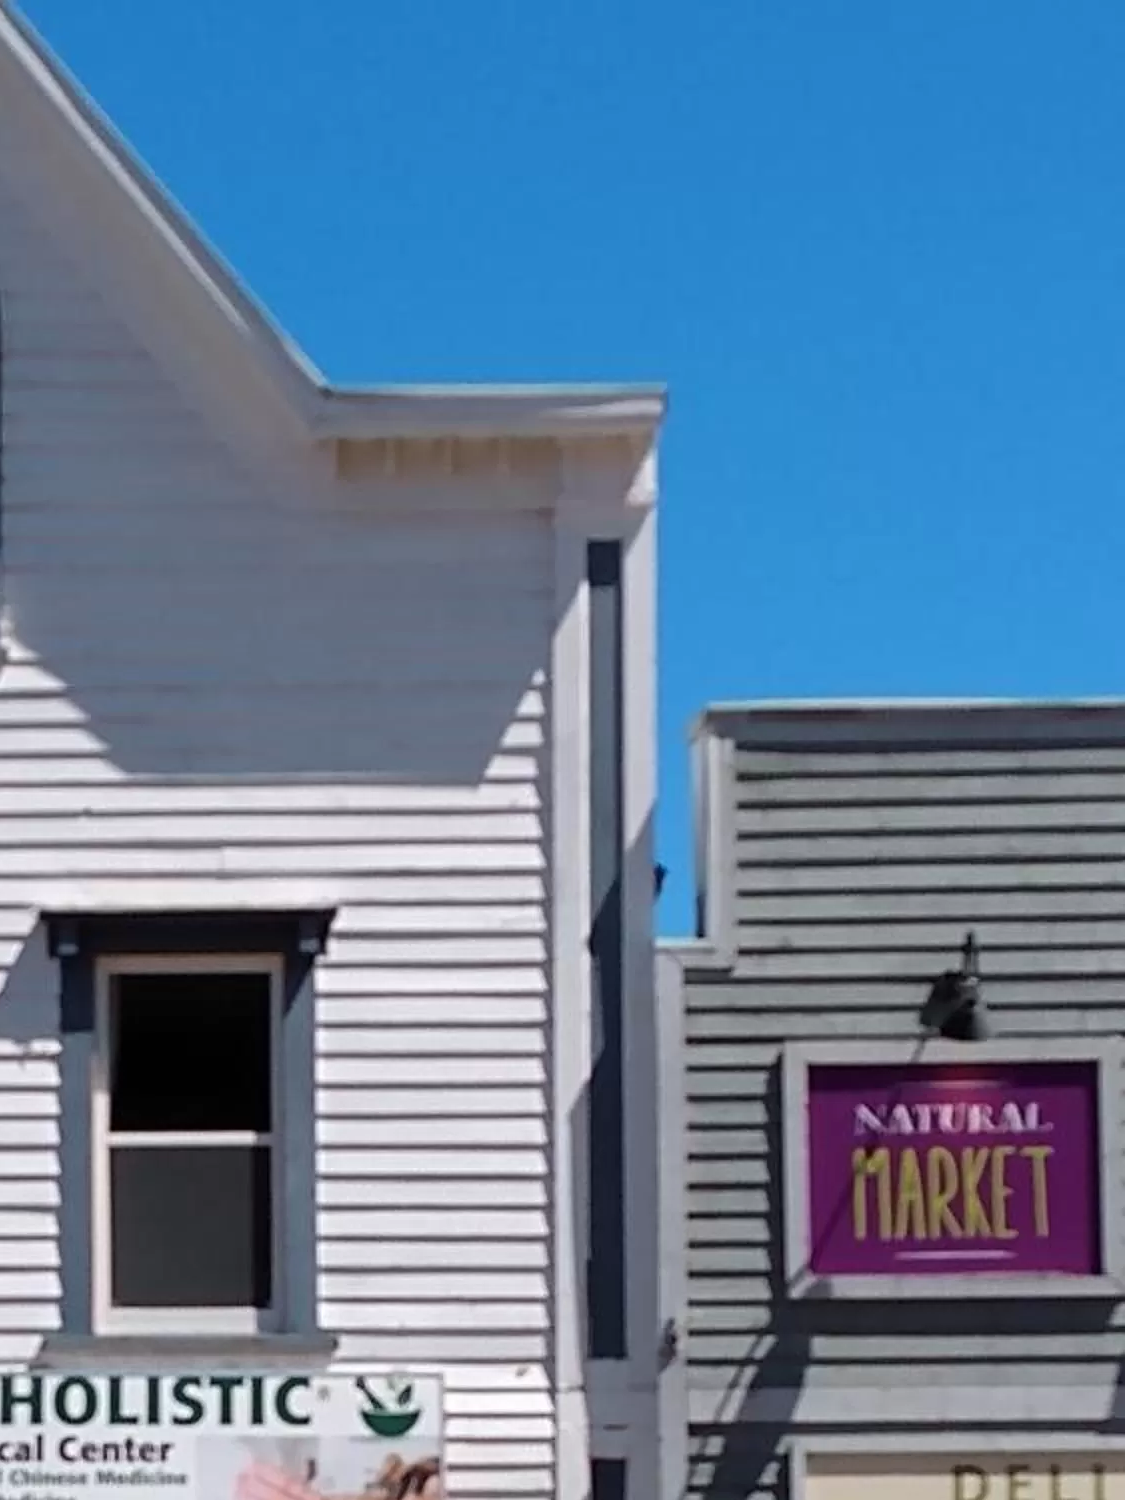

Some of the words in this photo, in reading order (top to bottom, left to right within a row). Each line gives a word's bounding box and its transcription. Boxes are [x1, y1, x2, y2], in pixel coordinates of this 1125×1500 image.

[854, 1102, 1054, 1135] NATURAL
[851, 1145, 1055, 1241] MARKET
[0, 1376, 312, 1426] HOLISTIC
[58, 1435, 173, 1463] Center
[9, 1469, 88, 1486] Chinese
[95, 1469, 188, 1486] Medicine
